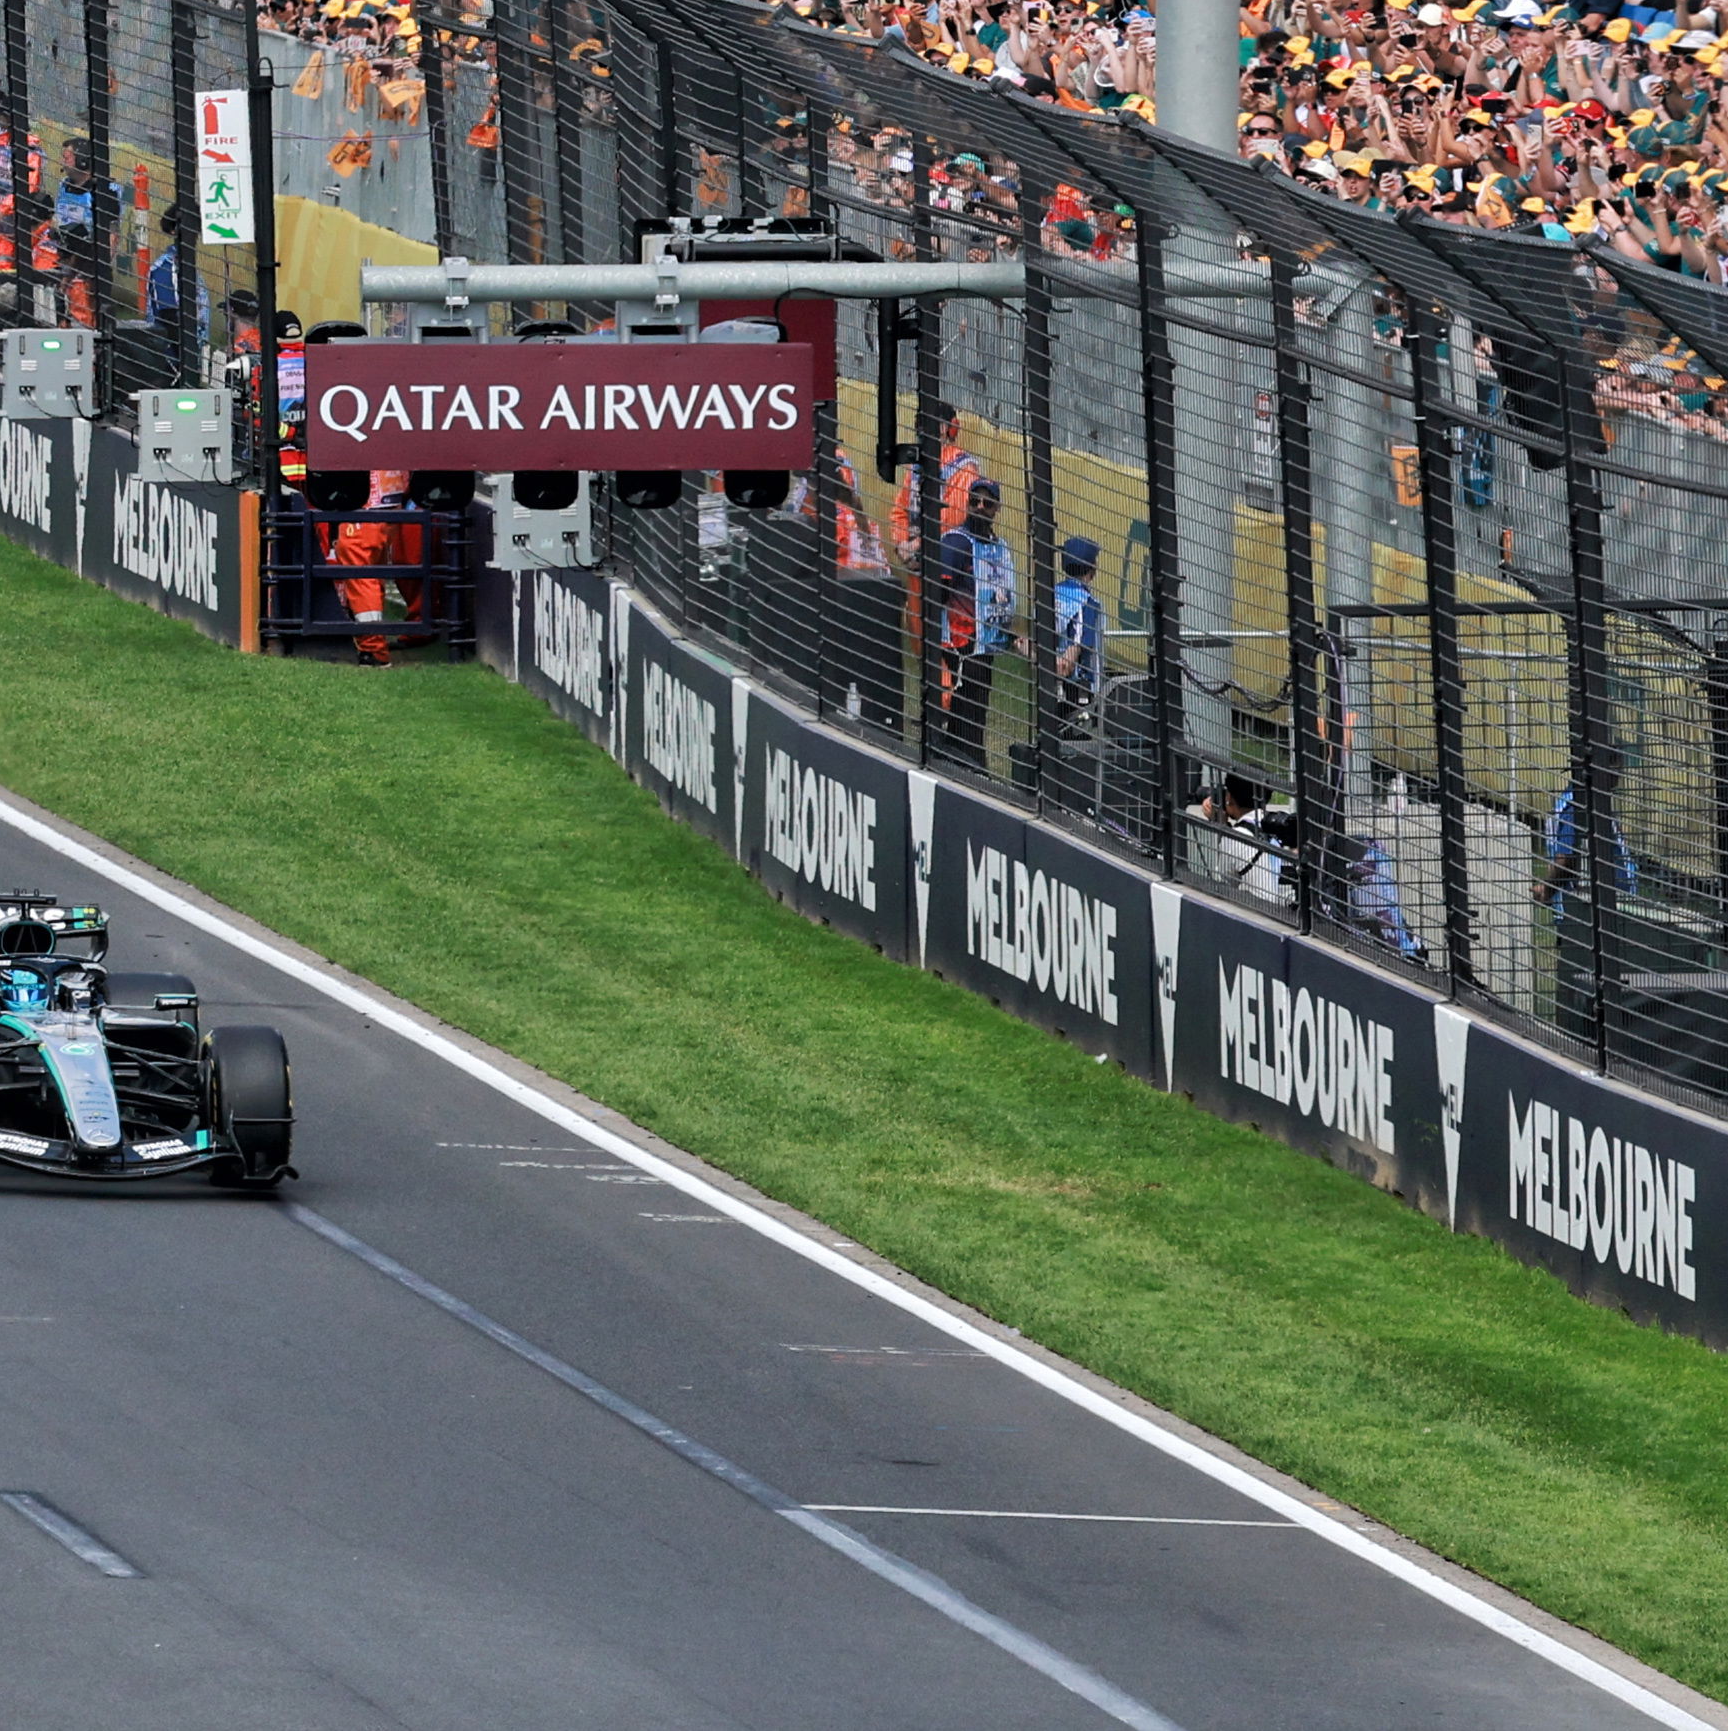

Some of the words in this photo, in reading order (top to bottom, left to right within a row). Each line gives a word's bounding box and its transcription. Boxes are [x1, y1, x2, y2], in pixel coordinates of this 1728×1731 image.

[205, 137, 239, 145] FIRE
[205, 212, 240, 220] EXIT
[320, 385, 523, 441] QATAR
[540, 384, 798, 431] AIRWAYS
[113, 470, 219, 611] MELBOURNE
[644, 657, 717, 813] MELBOURNE
[765, 741, 877, 913] MELBOURNE
[967, 836, 1118, 1026] MELBOURNE
[1219, 954, 1395, 1155] MELBOURNE
[1509, 1089, 1696, 1301] MELBOURNE
